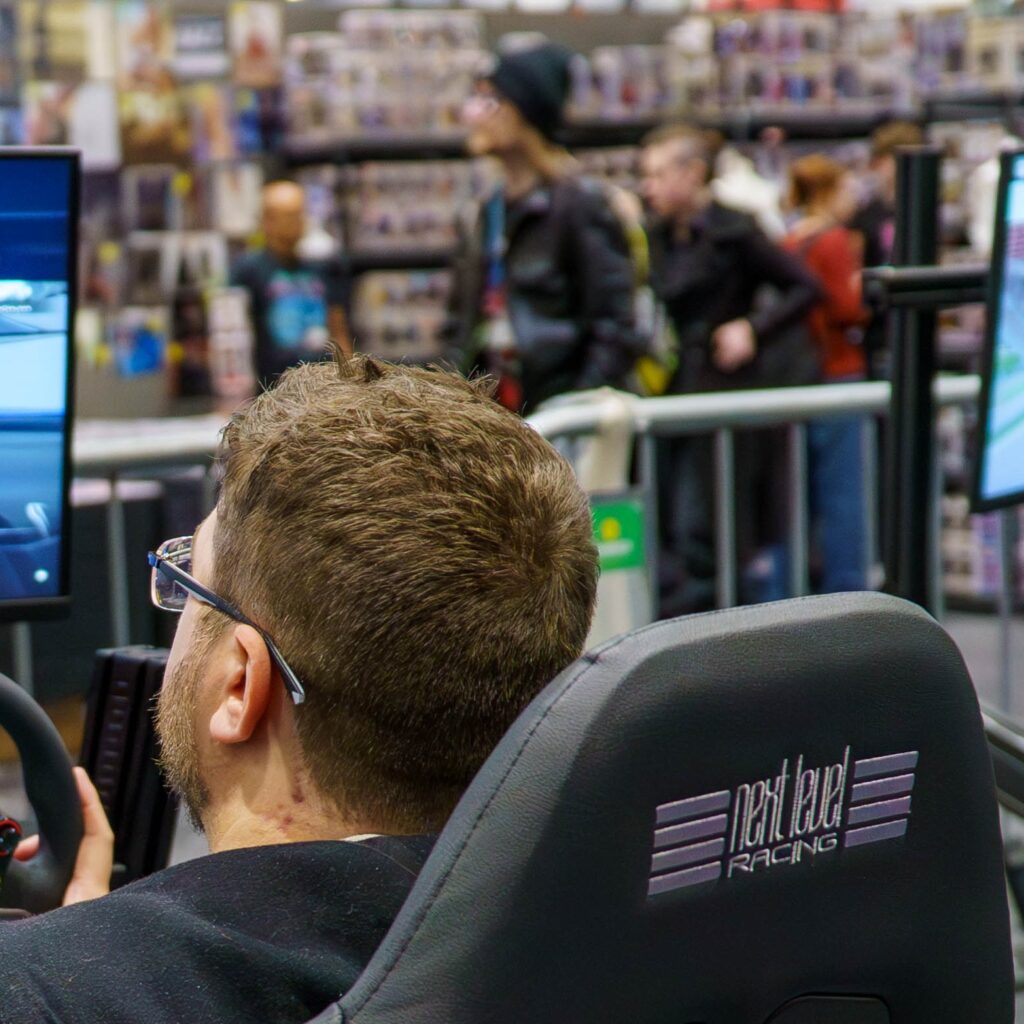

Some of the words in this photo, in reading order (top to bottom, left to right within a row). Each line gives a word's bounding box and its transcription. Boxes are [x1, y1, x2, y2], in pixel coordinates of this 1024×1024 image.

[729, 757, 790, 853] next
[789, 745, 850, 838] level
[727, 831, 838, 878] RACING
